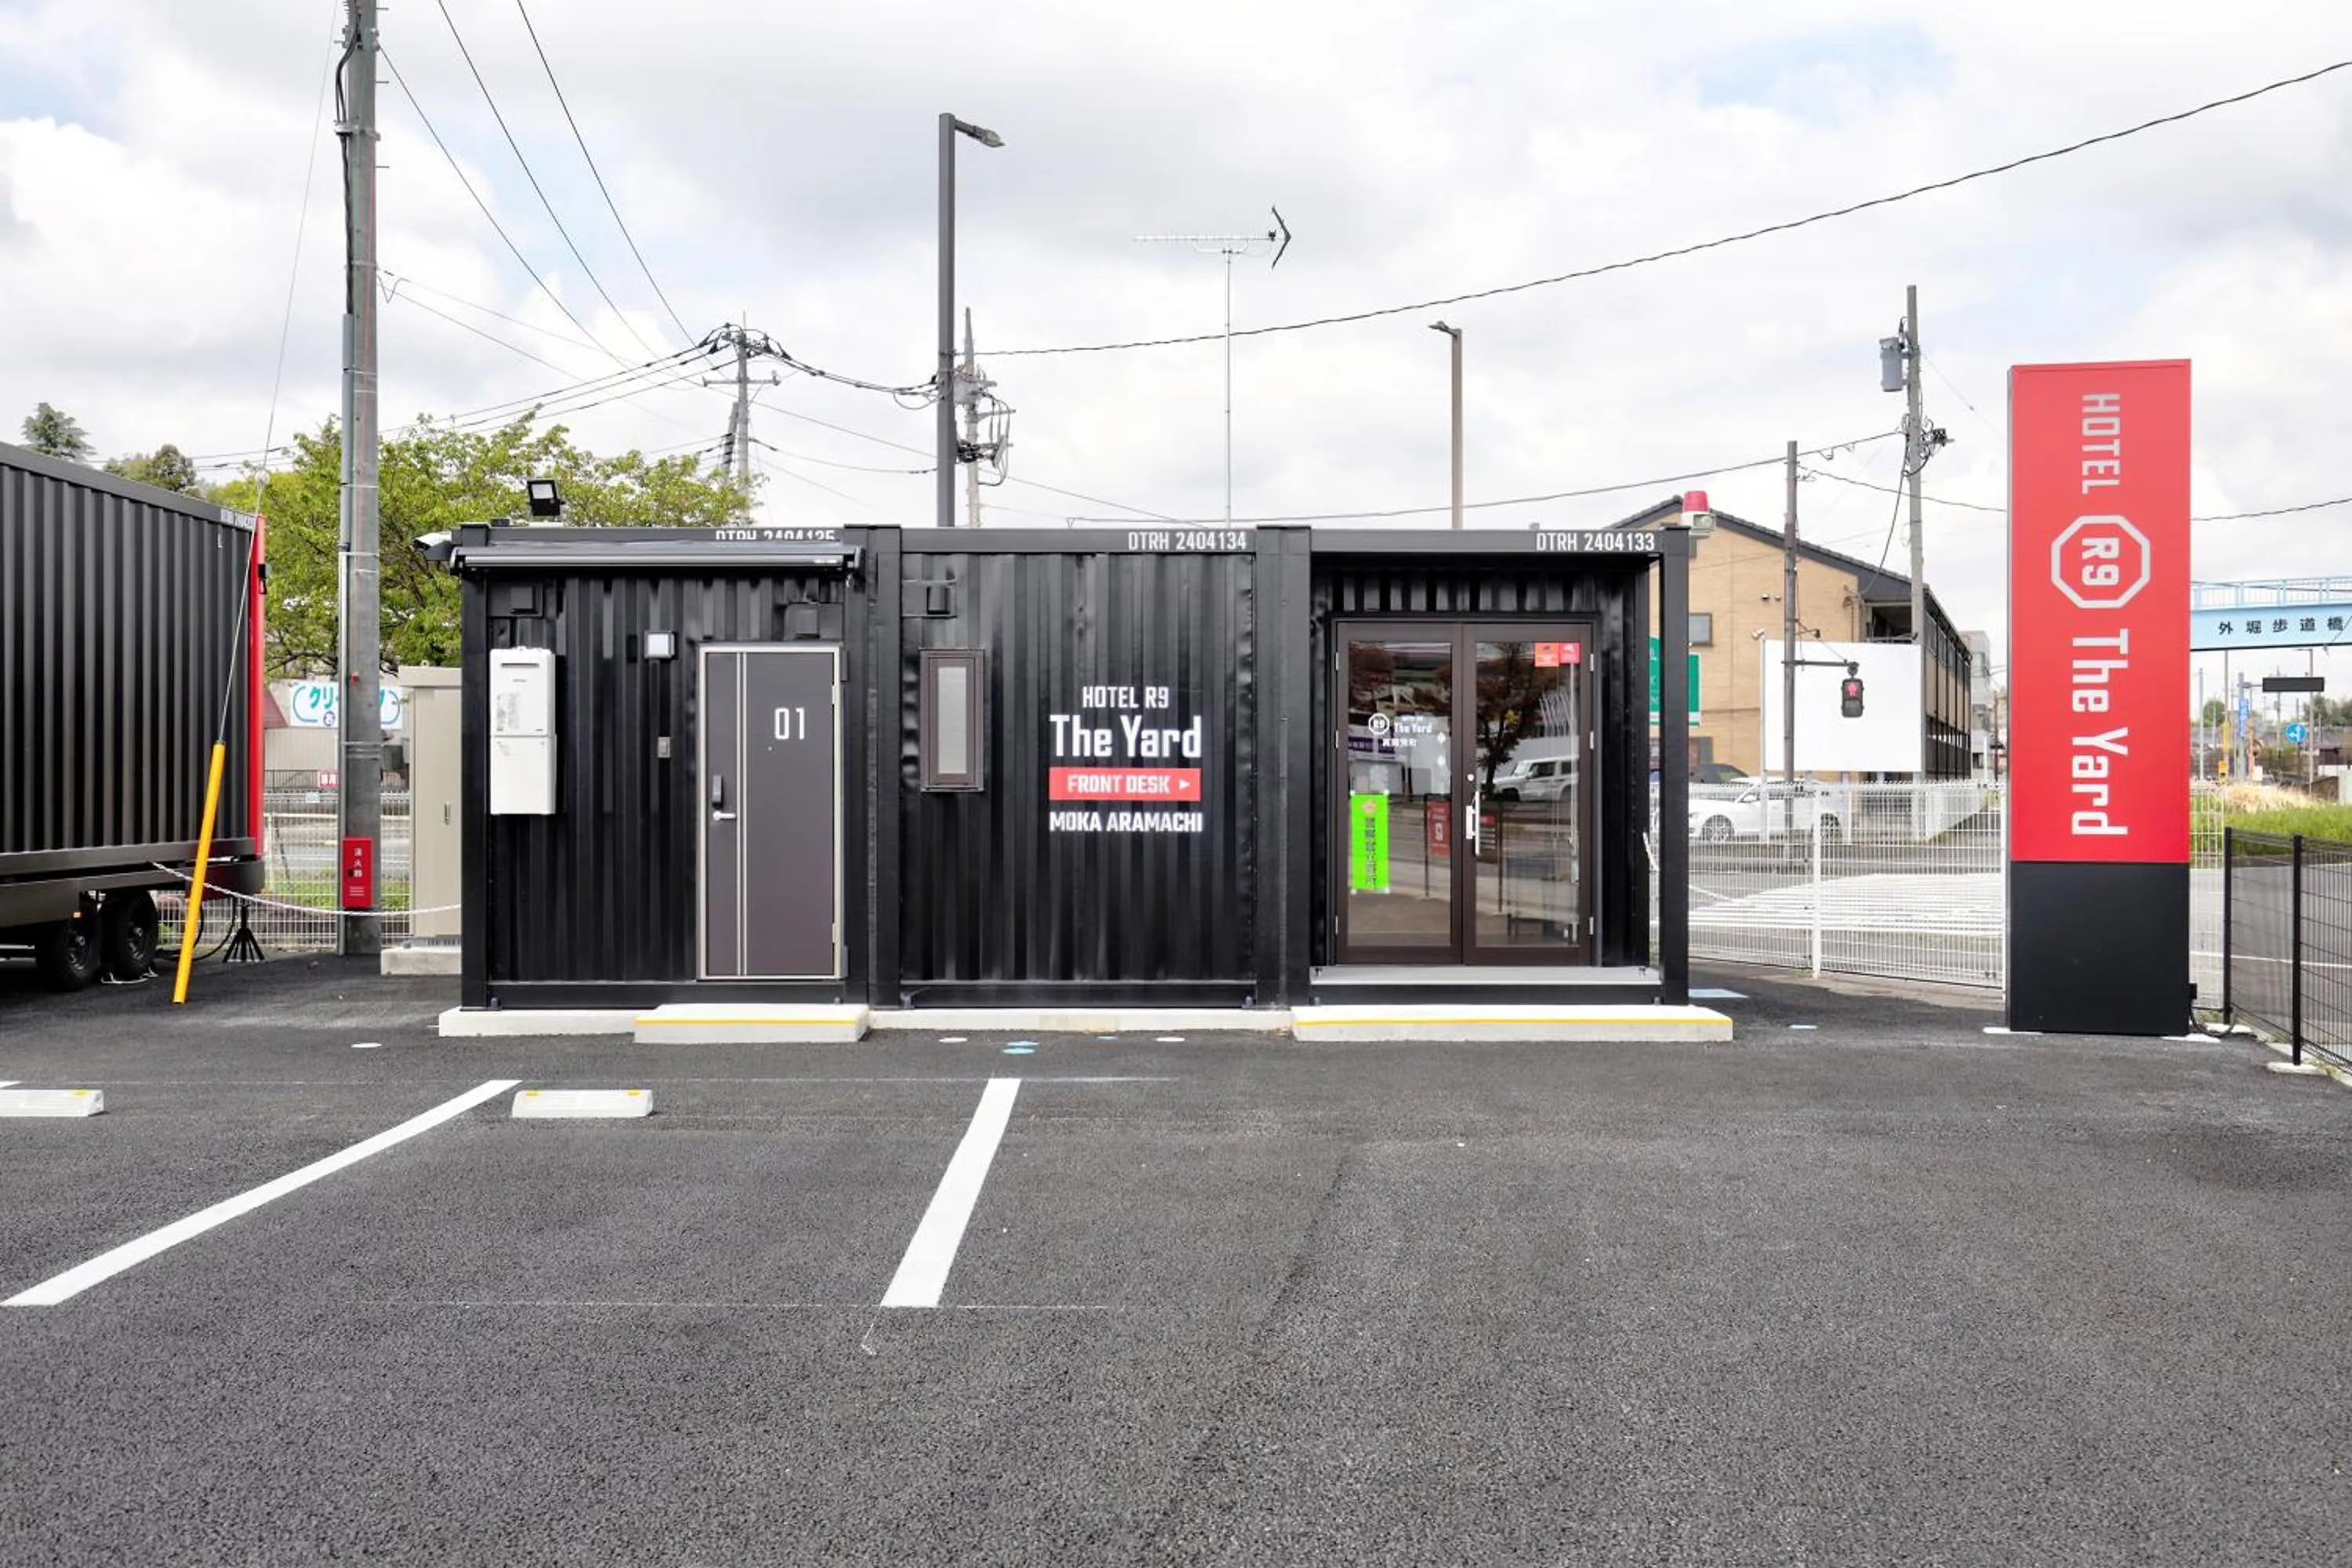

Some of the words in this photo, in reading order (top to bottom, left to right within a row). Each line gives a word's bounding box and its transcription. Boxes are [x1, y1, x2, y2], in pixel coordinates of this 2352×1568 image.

[2082, 393, 2121, 495] HOTEL
[1128, 531, 1170, 551] DTRH
[1175, 531, 1247, 551] 2404134
[1536, 532, 1577, 552] DTRH
[1584, 532, 1655, 552] 2404133
[2082, 536, 2120, 586] R9
[2217, 615, 2343, 636] 外堀歩道橋
[2071, 628, 2129, 713] The
[1082, 686, 1139, 709] HOTEL
[1145, 686, 1169, 709] R9
[775, 707, 805, 741] 01
[1049, 714, 1113, 757] The
[1120, 714, 1202, 758] Yard
[1067, 774, 1123, 794] FRONT
[1125, 774, 1171, 794] DESK
[2071, 727, 2129, 836] Yard
[1049, 811, 1102, 833] MOKA
[1105, 811, 1203, 833] ARAMACHI
